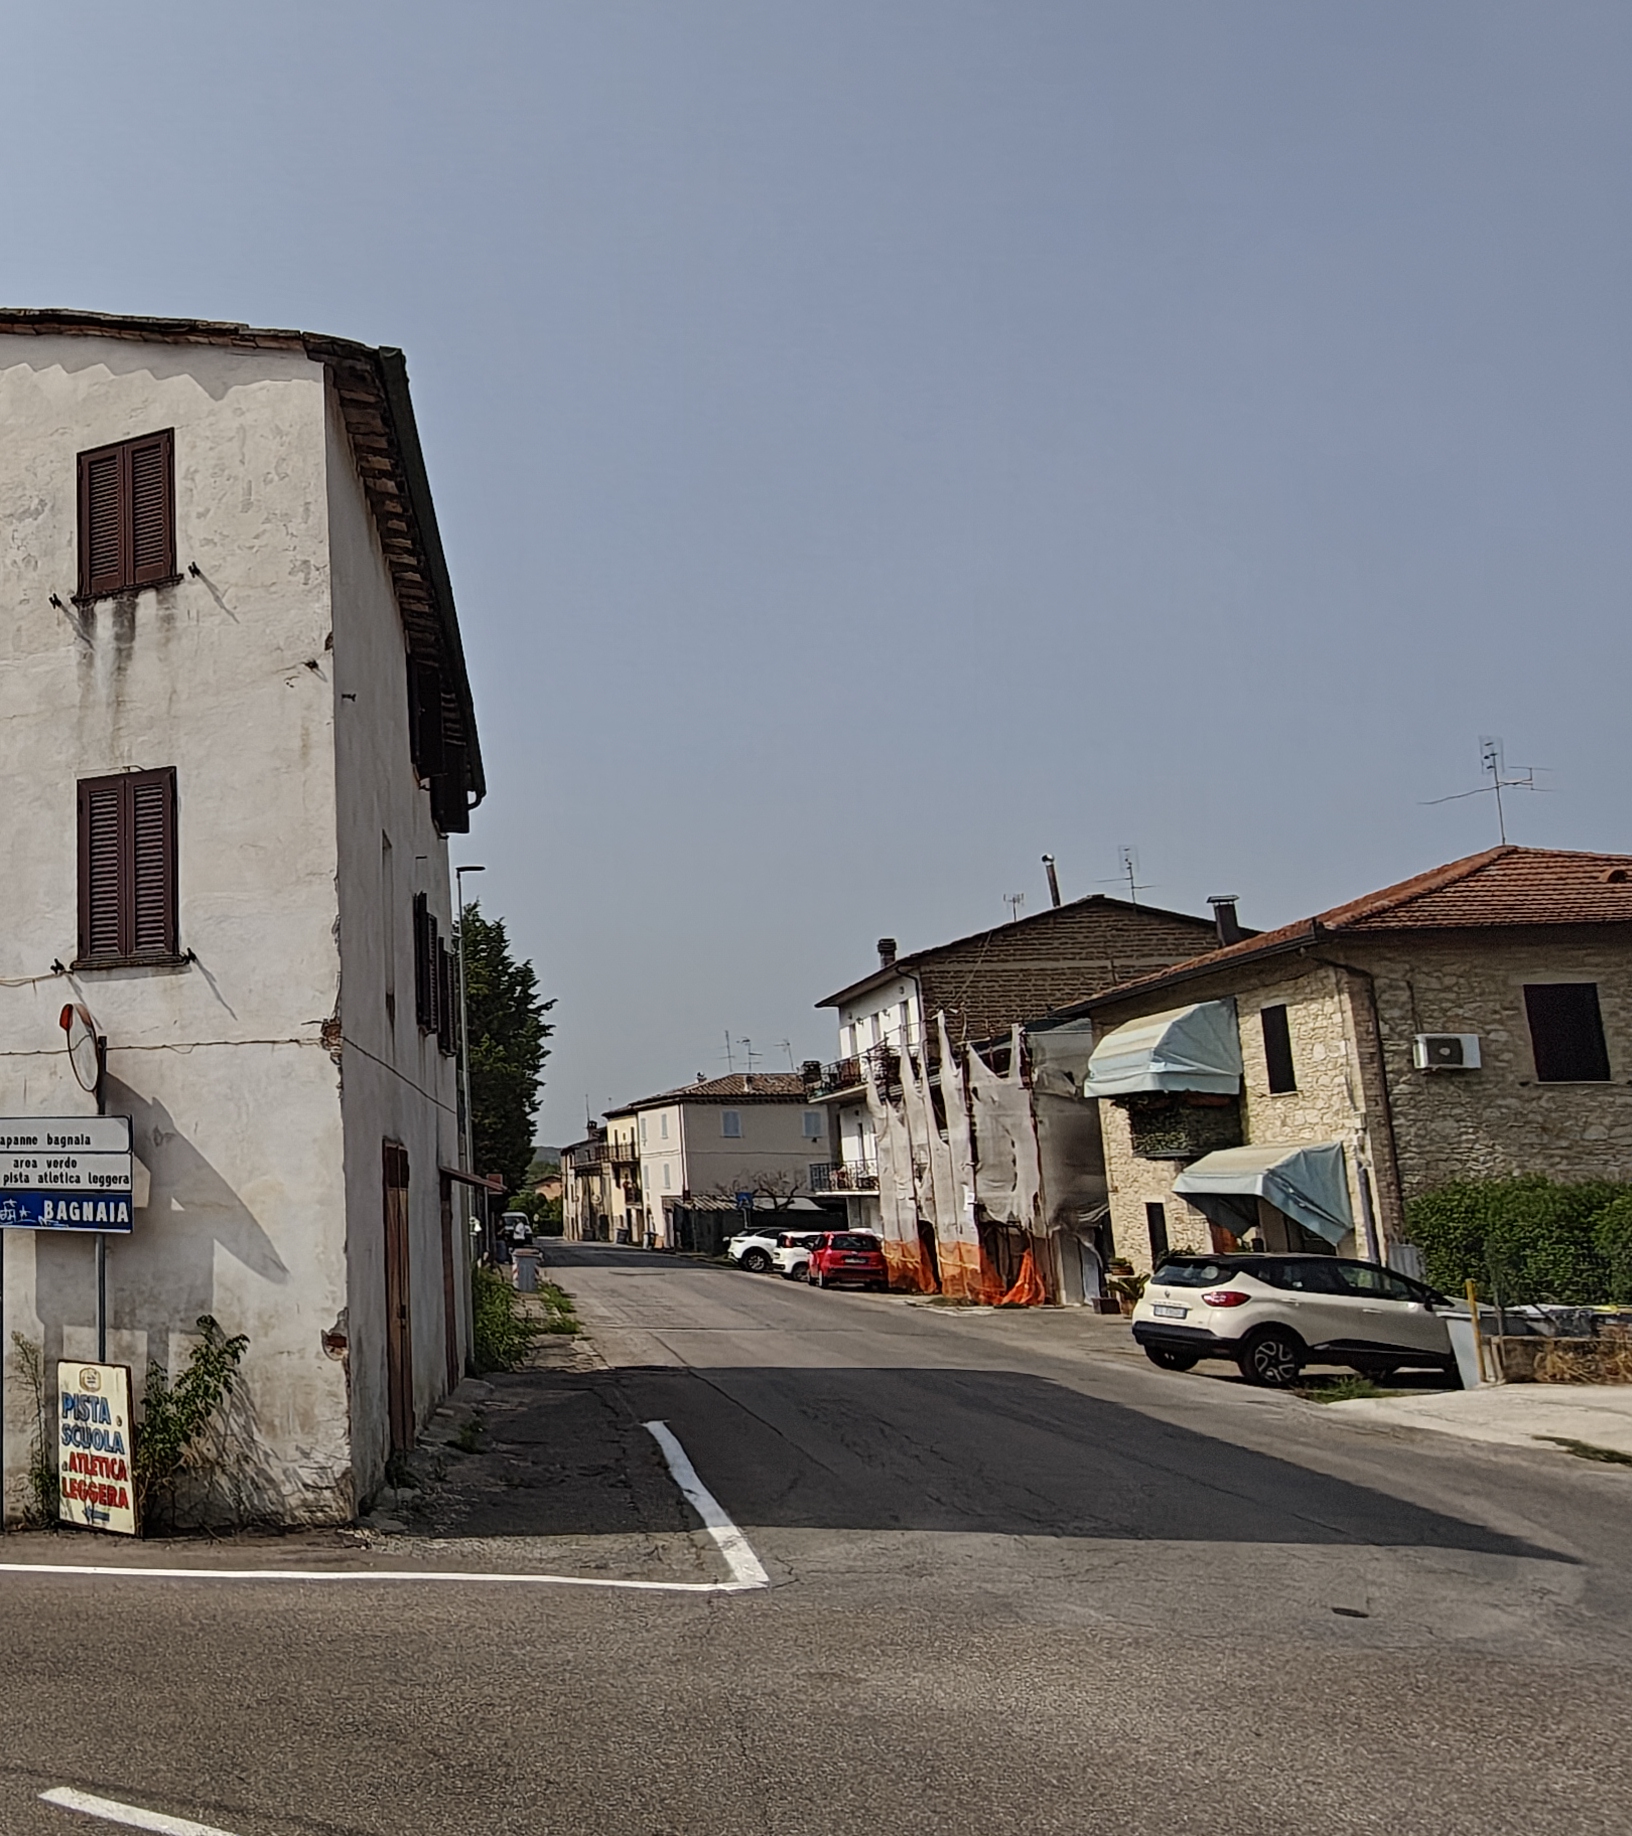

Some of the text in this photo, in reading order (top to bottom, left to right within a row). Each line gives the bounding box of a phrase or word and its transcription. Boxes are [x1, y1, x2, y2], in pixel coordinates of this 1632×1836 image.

[47, 1133, 91, 1148] bagnaia
[13, 1157, 77, 1169] area verde
[3, 1172, 130, 1187] pista atletica leggera
[44, 1200, 129, 1223] BAGNAIA
[61, 1391, 111, 1425] PISTA
[61, 1424, 125, 1455] SCUOLA
[69, 1451, 128, 1482] ATLETICA
[61, 1477, 129, 1509] LEGGERA
